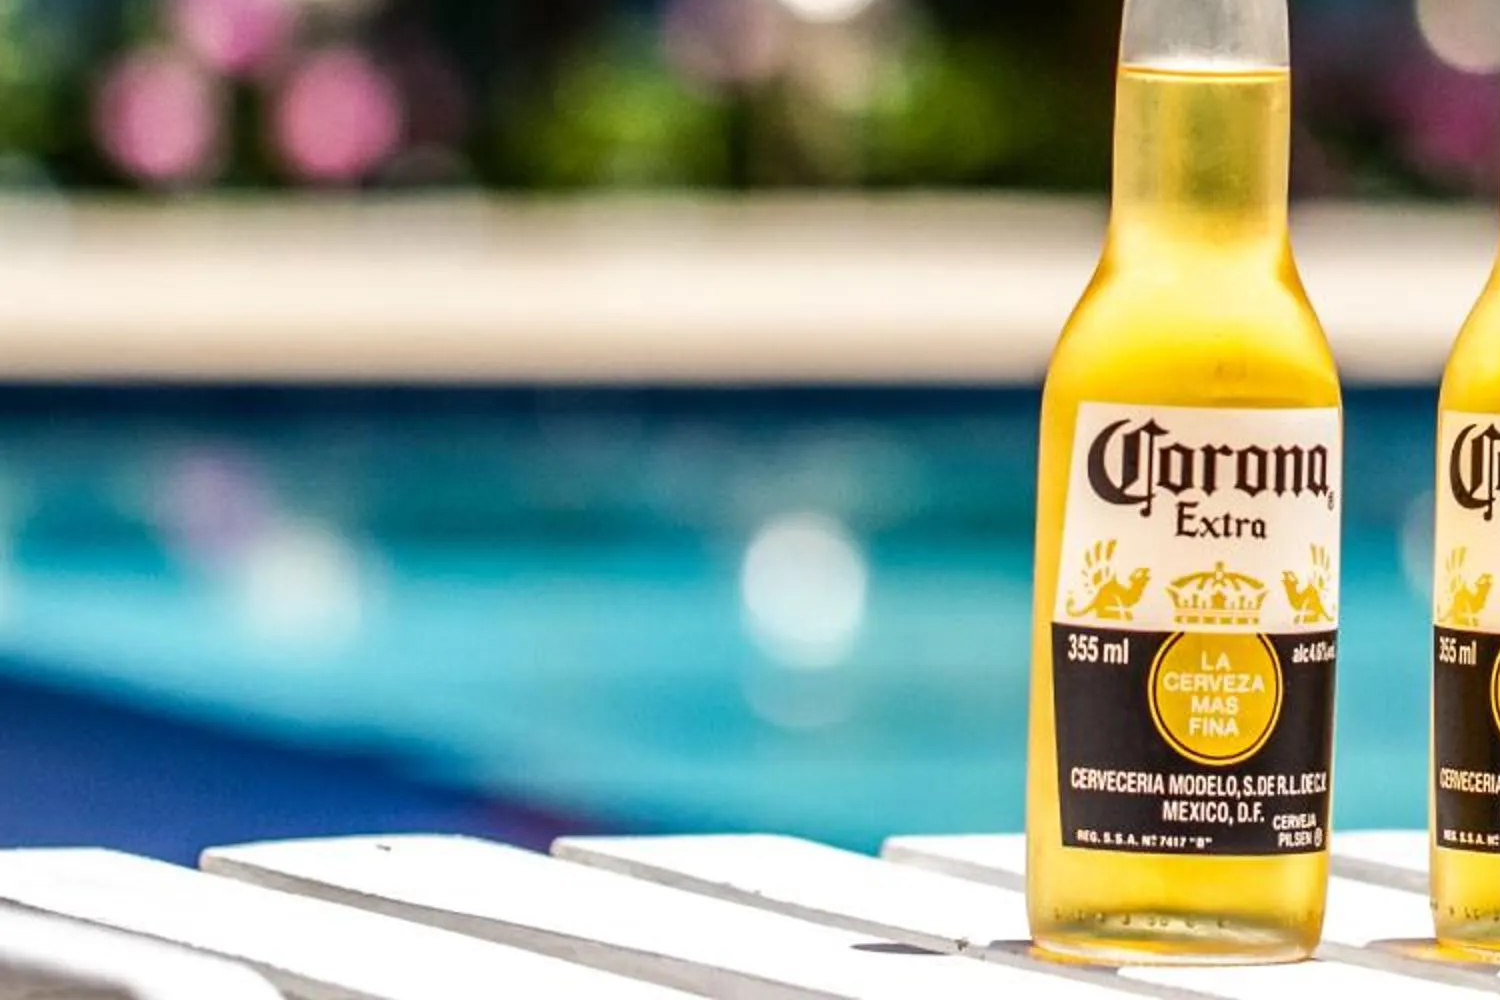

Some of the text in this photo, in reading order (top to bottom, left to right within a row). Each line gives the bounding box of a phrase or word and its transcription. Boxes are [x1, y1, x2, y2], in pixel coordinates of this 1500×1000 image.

[1087, 417, 1330, 518] Corona
[1175, 501, 1267, 539] Extra
[1067, 633, 1129, 664] 355 ml
[1201, 651, 1231, 671] LA
[1459, 640, 1477, 666] ml
[1163, 673, 1265, 693] CERVEZA
[1191, 696, 1239, 713] MAS
[1188, 718, 1239, 736] FINA
[1071, 767, 1164, 795] CERVECERIA
[1169, 773, 1241, 799] MODELO,
[1162, 800, 1265, 827] MEXICO, D.F.
